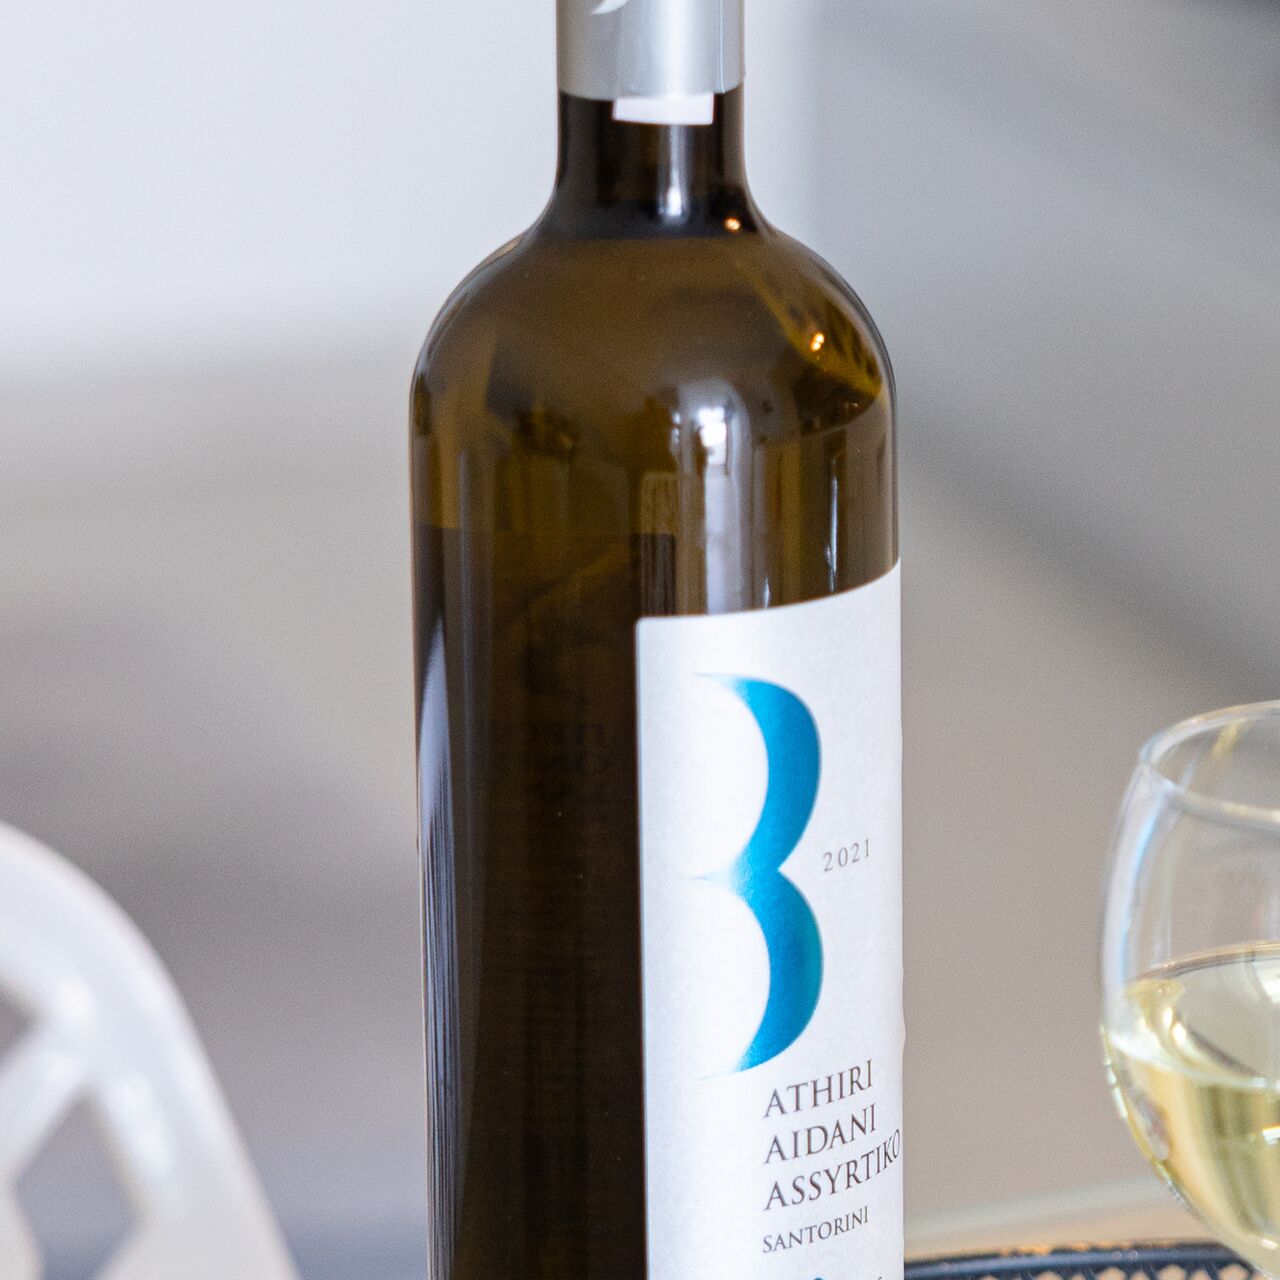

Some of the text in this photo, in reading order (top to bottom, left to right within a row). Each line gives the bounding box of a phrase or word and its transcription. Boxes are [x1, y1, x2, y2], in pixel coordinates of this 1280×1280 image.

[822, 837, 870, 873] 2021
[762, 1057, 873, 1119] ATHIRI
[762, 1102, 877, 1165] AIDANI
[763, 1128, 900, 1211] ASSYRTIKO
[762, 1205, 869, 1254] SANTORINI
